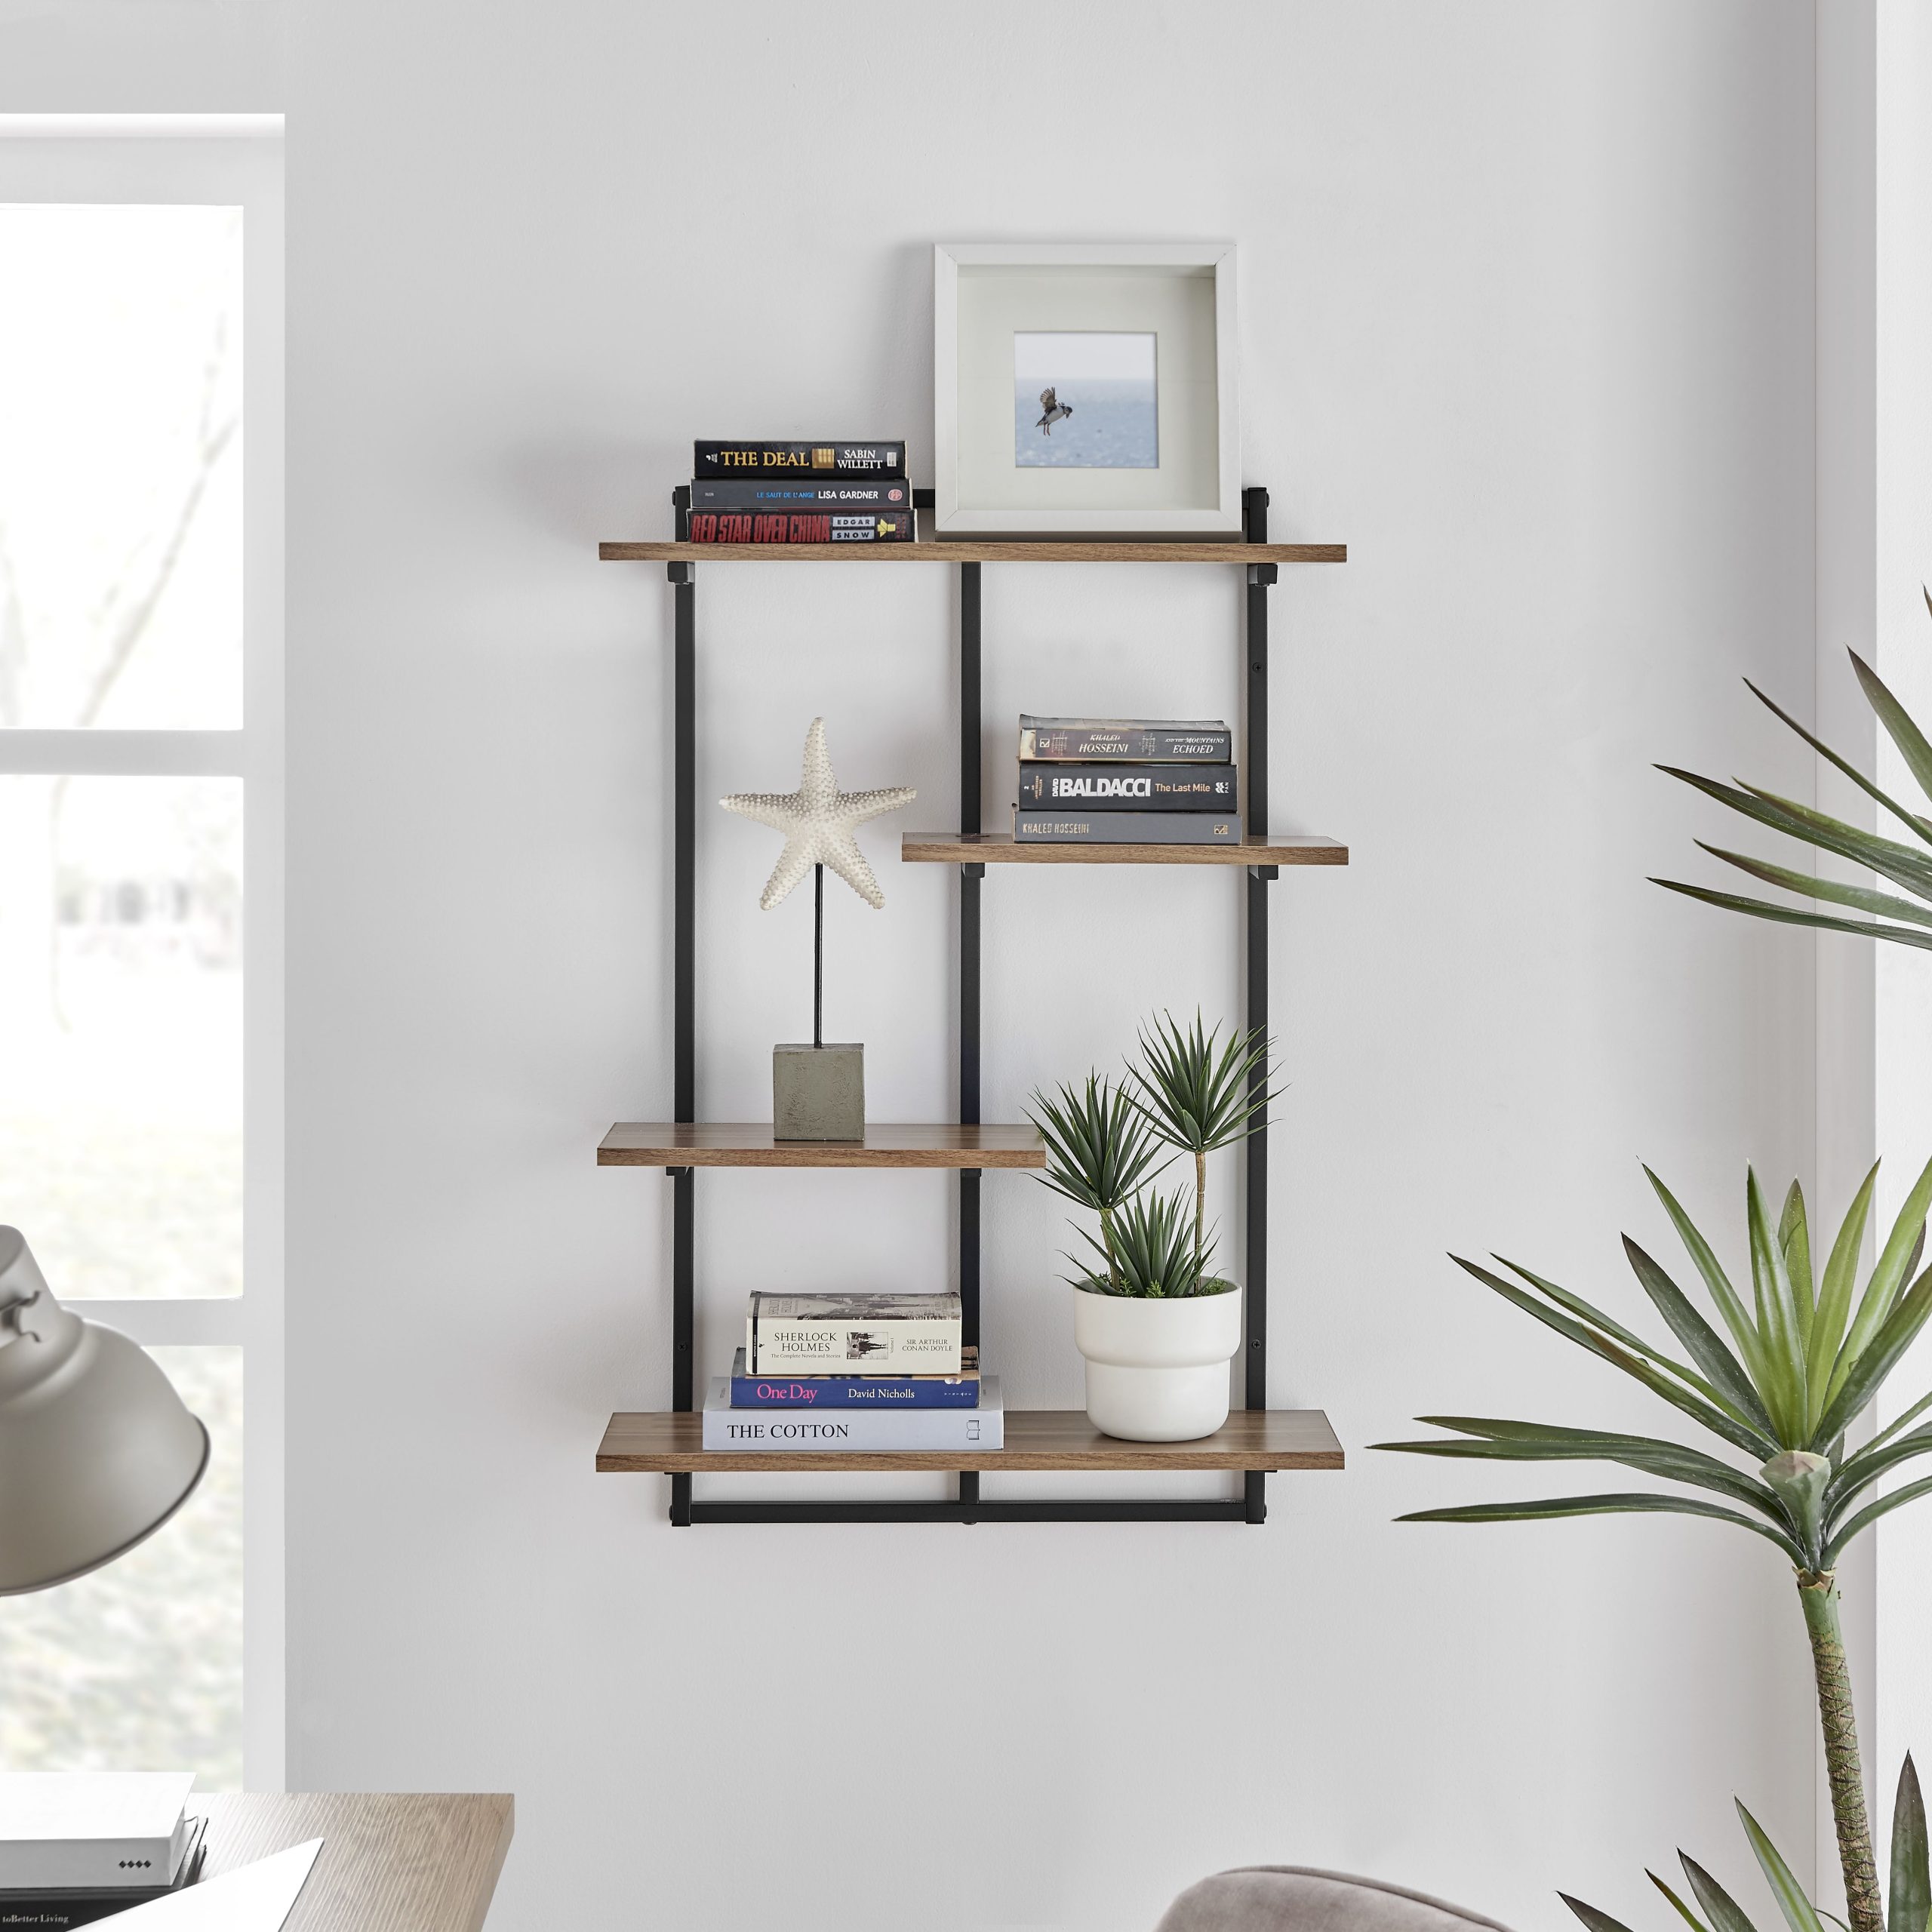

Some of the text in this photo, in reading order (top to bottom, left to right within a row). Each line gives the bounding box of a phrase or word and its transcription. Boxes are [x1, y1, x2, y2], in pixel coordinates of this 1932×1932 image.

[721, 451, 758, 466] THE
[763, 451, 810, 466] DEAL
[844, 449, 875, 459] SABIN
[837, 460, 883, 469] WILLETT
[818, 491, 878, 499] LISA GARDNER
[691, 515, 830, 543] RED STAR OVER CHINA
[1078, 743, 1128, 753] HOSSEINI
[1173, 745, 1214, 754] ECHOED
[1060, 778, 1151, 797] BALDACCI
[1155, 783, 1211, 792] The Last Mile
[1023, 823, 1090, 834] KHALED HOSSEINI
[774, 1333, 837, 1341] SHERLOCK
[782, 1343, 830, 1352] HOLMES
[757, 1384, 818, 1404] One Day
[848, 1389, 915, 1398] David Nicholls
[727, 1424, 849, 1438] THE COTTON
